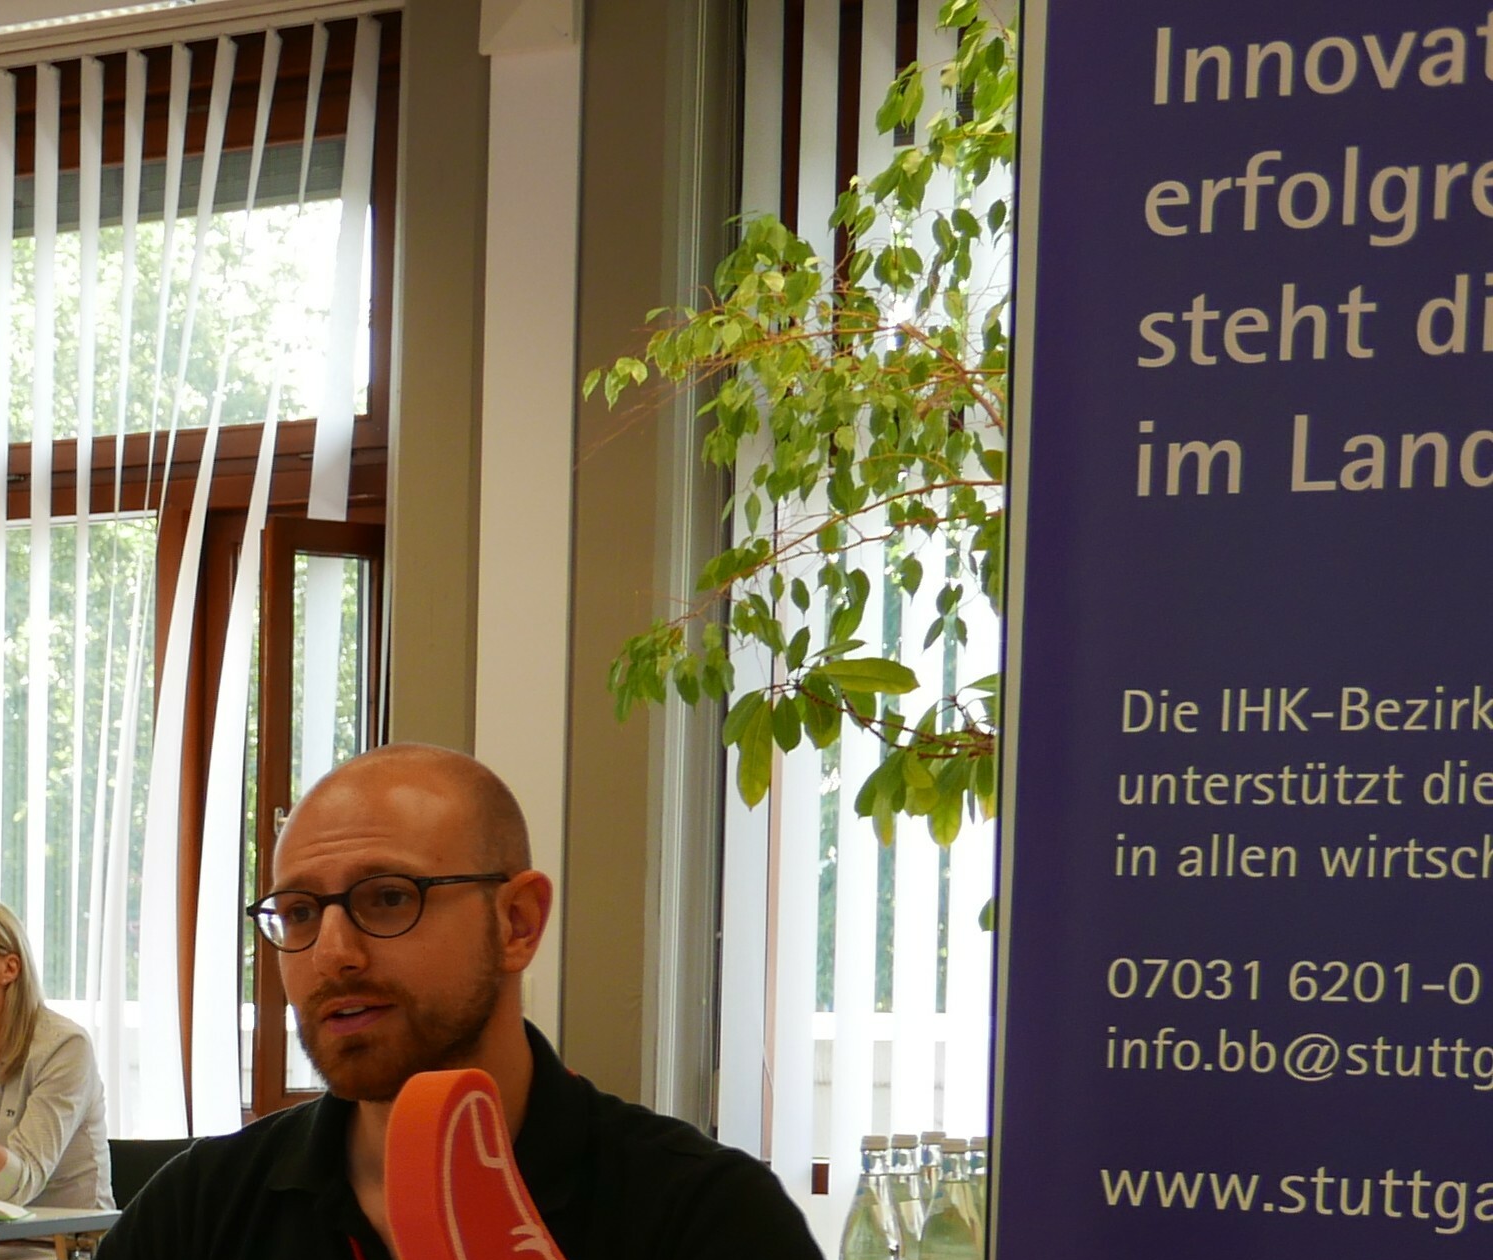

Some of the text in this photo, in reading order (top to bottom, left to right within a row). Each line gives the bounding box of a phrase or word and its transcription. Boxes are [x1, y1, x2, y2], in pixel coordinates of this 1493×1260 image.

[1137, 283, 1377, 368] steht
[1136, 420, 1242, 497] im
[1121, 685, 1493, 733] Die IHK-Bezirk
[1118, 760, 1493, 806] unterstützt die
[1115, 834, 1156, 877] in
[1177, 834, 1297, 878] allen
[1107, 957, 1480, 1005] 07031 6201-0
